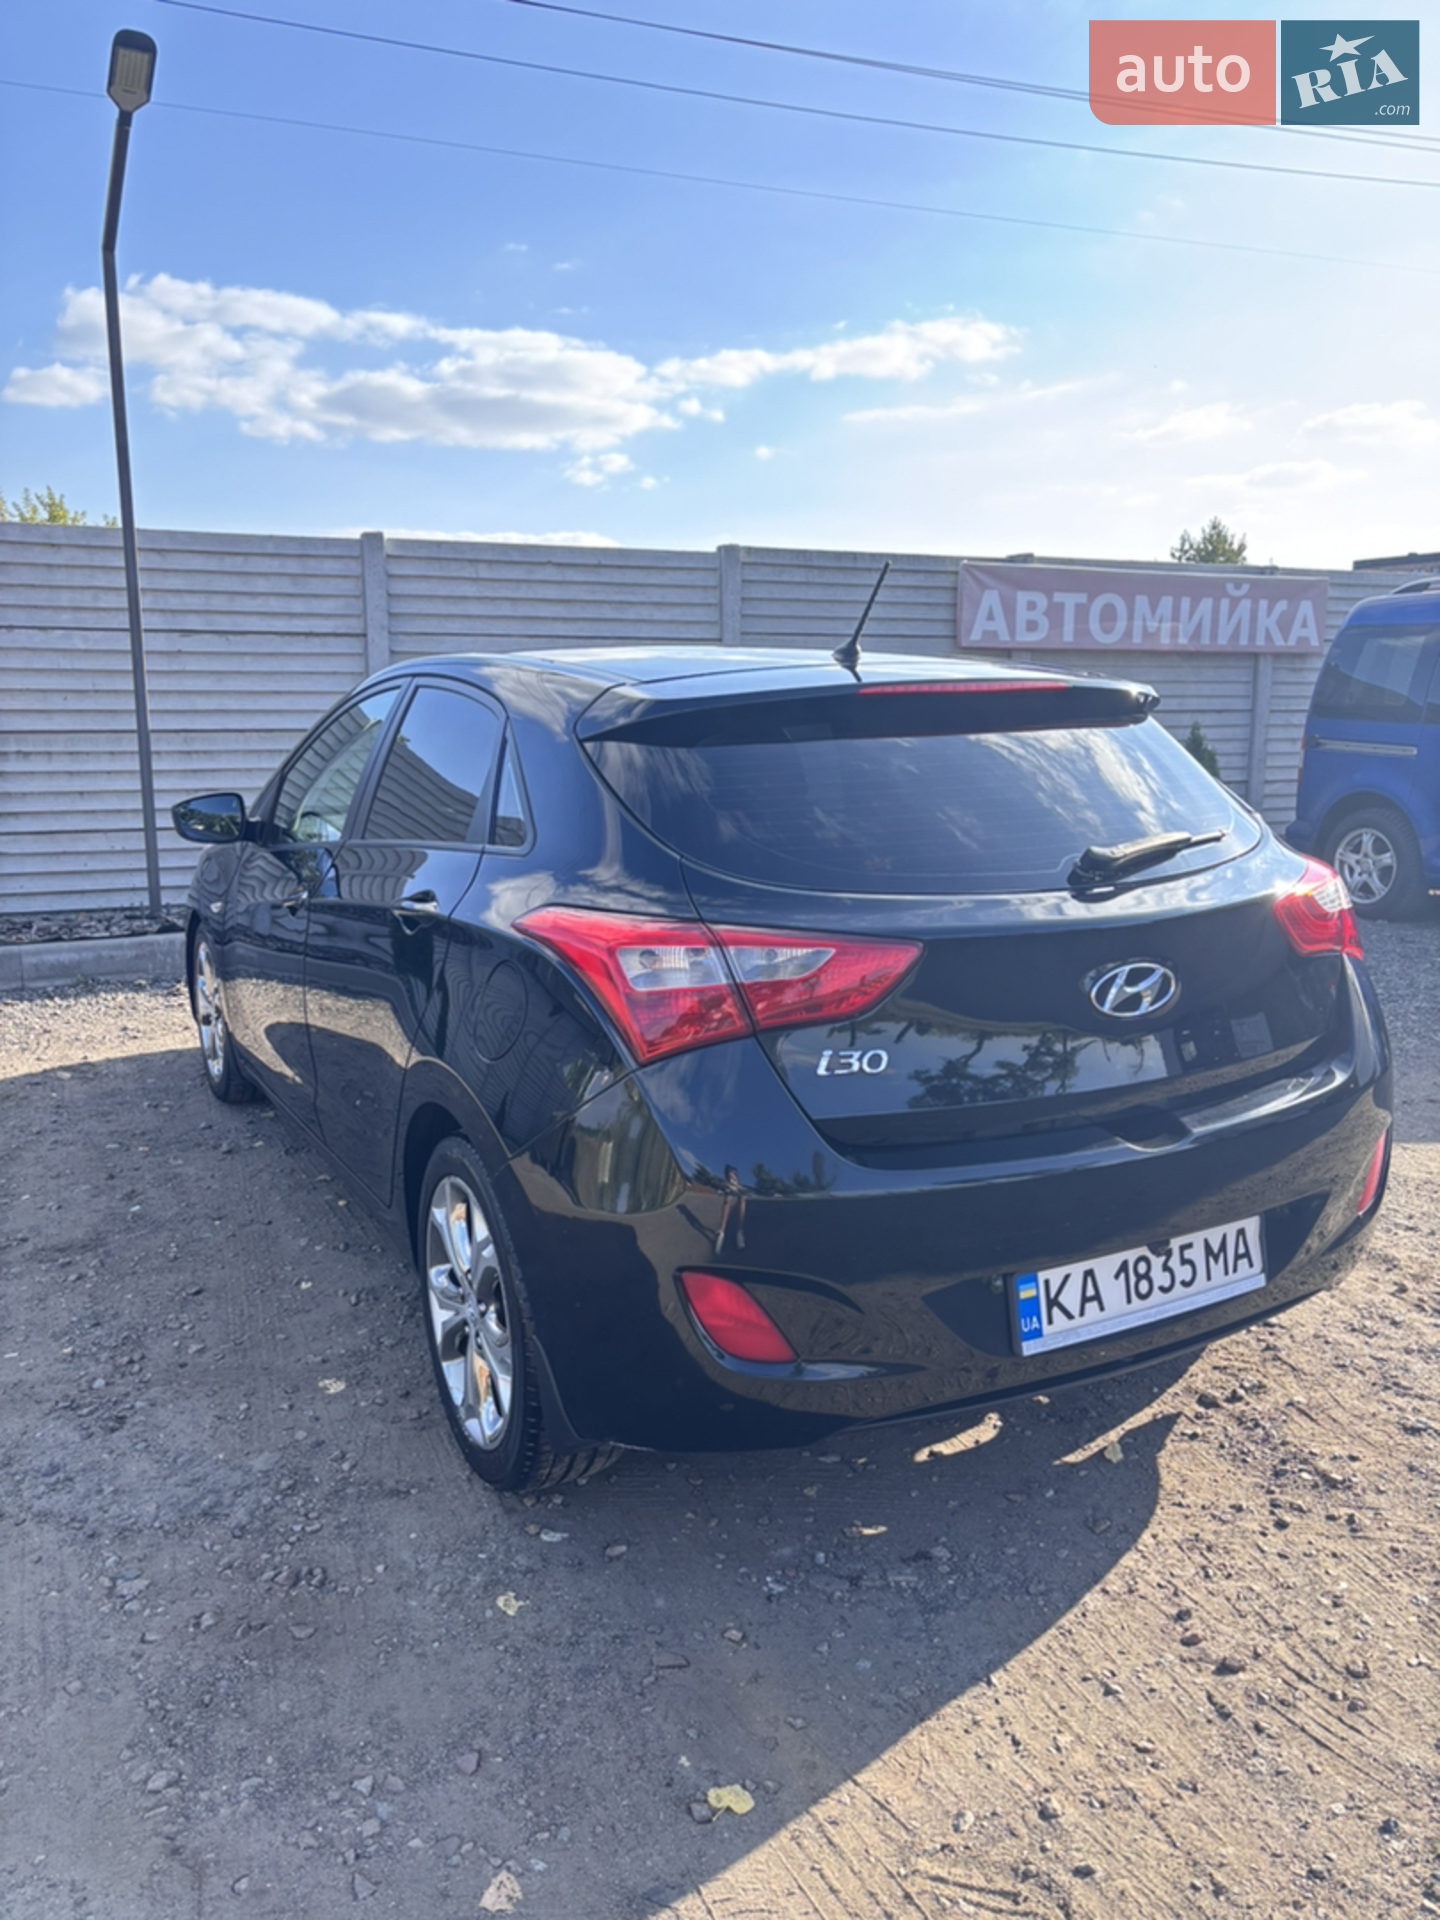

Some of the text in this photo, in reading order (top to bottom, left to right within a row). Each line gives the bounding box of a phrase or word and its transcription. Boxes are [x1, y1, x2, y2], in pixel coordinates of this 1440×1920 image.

[969, 582, 1320, 646] АВТОМИЙКА
[816, 1049, 889, 1076] i30
[1043, 1227, 1254, 1326] KA 1835 MA
[1021, 1316, 1041, 1333] UA
